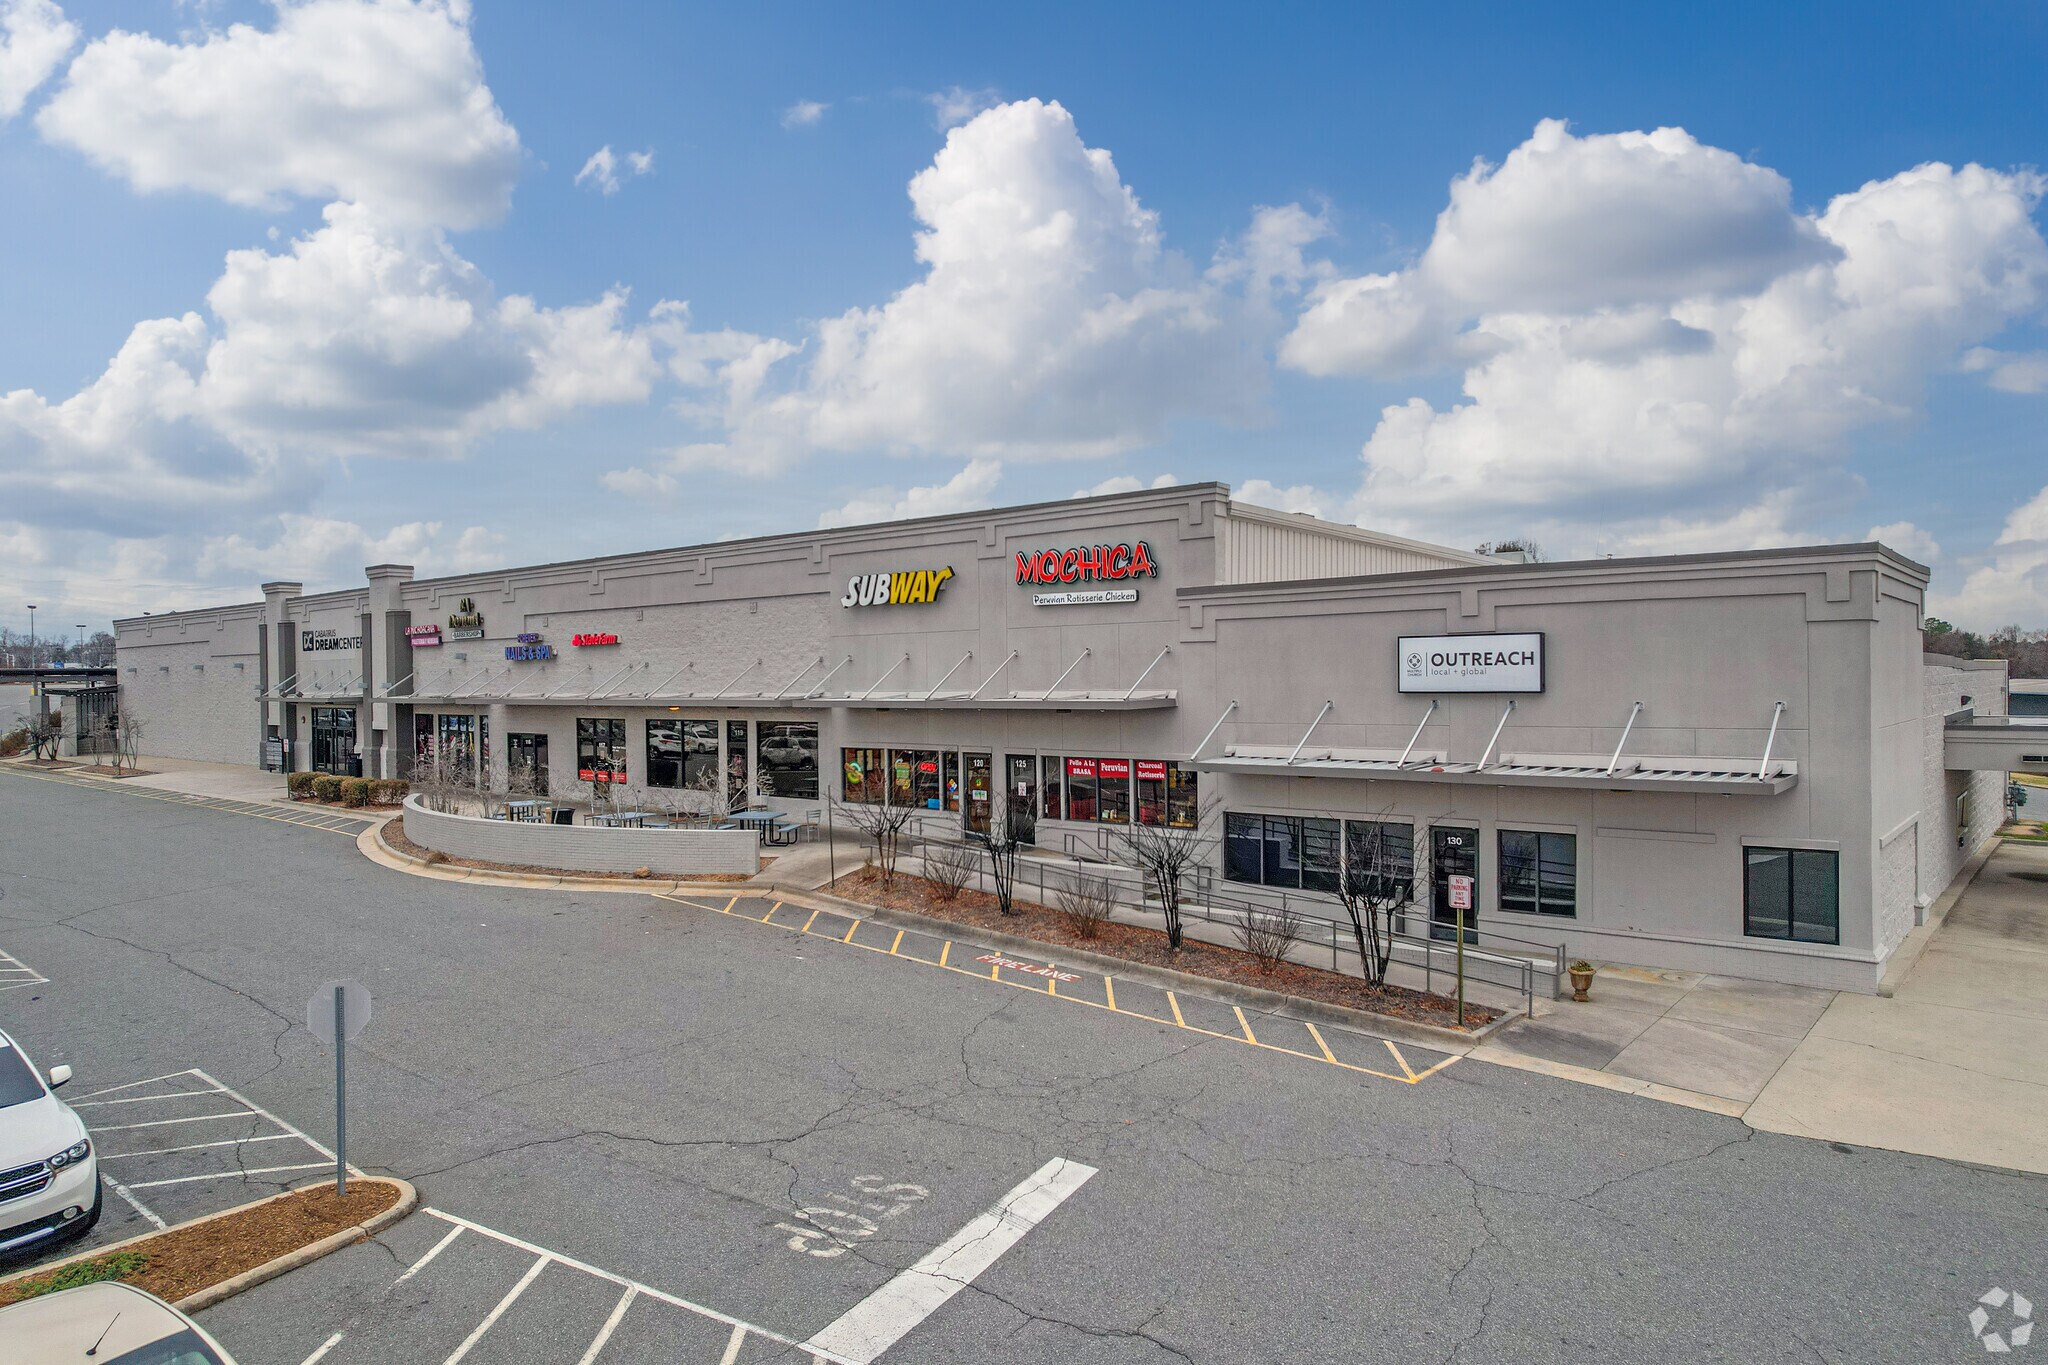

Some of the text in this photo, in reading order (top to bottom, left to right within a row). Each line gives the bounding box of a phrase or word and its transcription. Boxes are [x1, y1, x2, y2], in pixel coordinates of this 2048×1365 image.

[1015, 542, 1155, 586] MOCHICA
[841, 566, 955, 608] SUBWAY
[1034, 592, 1135, 604] Peruvian Rotisserie Chicken
[315, 629, 336, 638] CABARRUS
[505, 645, 550, 660] NAILS & SPA
[1431, 651, 1535, 666] OUTREACH
[1431, 668, 1450, 676] local
[1461, 668, 1487, 677] global
[920, 763, 937, 772] OPEN
[973, 759, 984, 767] 120
[1015, 760, 1026, 768] 125
[1101, 763, 1128, 772] Peruvian
[1138, 762, 1162, 770] Charcoal
[1138, 771, 1165, 779] Rotisserie
[1447, 836, 1462, 845] 130
[976, 954, 1082, 982] FIRE LANE
